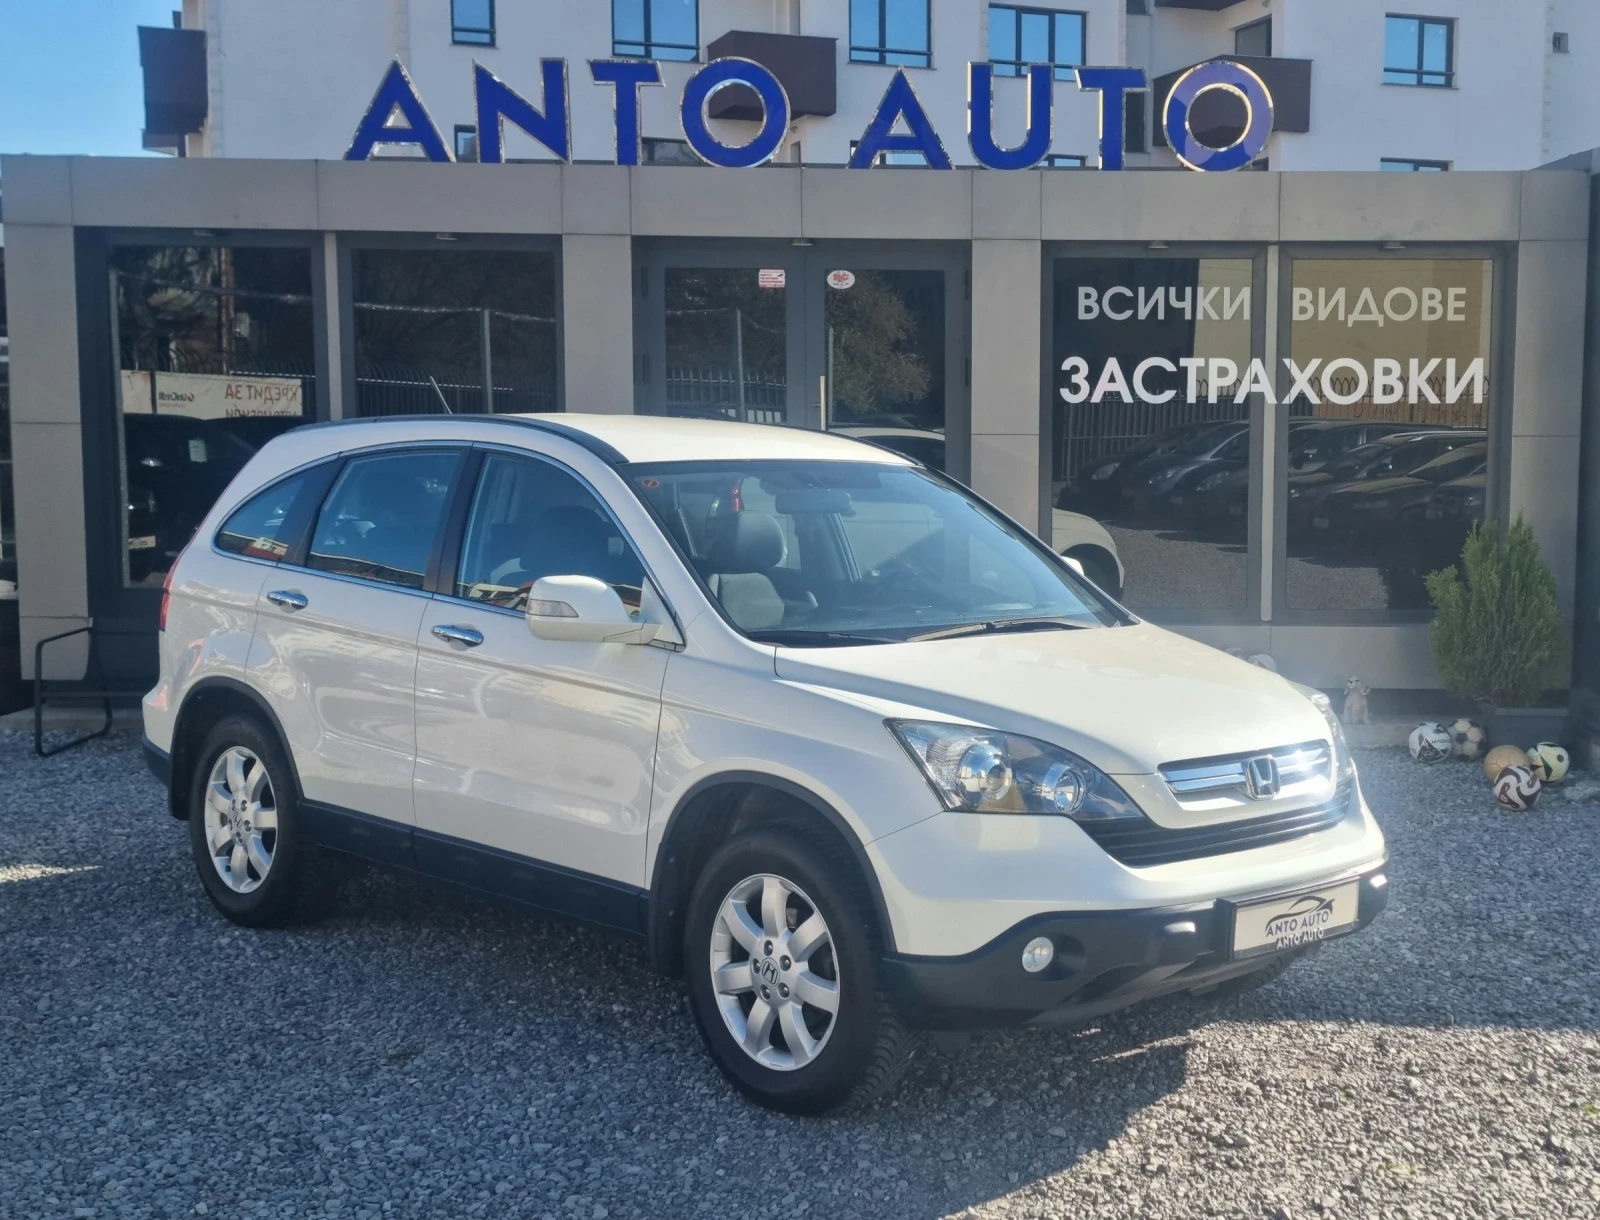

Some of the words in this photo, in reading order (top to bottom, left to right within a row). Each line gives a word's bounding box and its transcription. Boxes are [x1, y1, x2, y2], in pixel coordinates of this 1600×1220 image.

[344, 56, 792, 169] ANTO
[849, 60, 1276, 171] AUTO
[1078, 286, 1251, 320] ВСИЧКИ
[1293, 287, 1467, 327] ВИДОВЕ
[1060, 356, 1484, 405] ЗАСТРАХОВКИ
[1266, 919, 1298, 938] ANTO
[1301, 911, 1329, 928] AUTO
